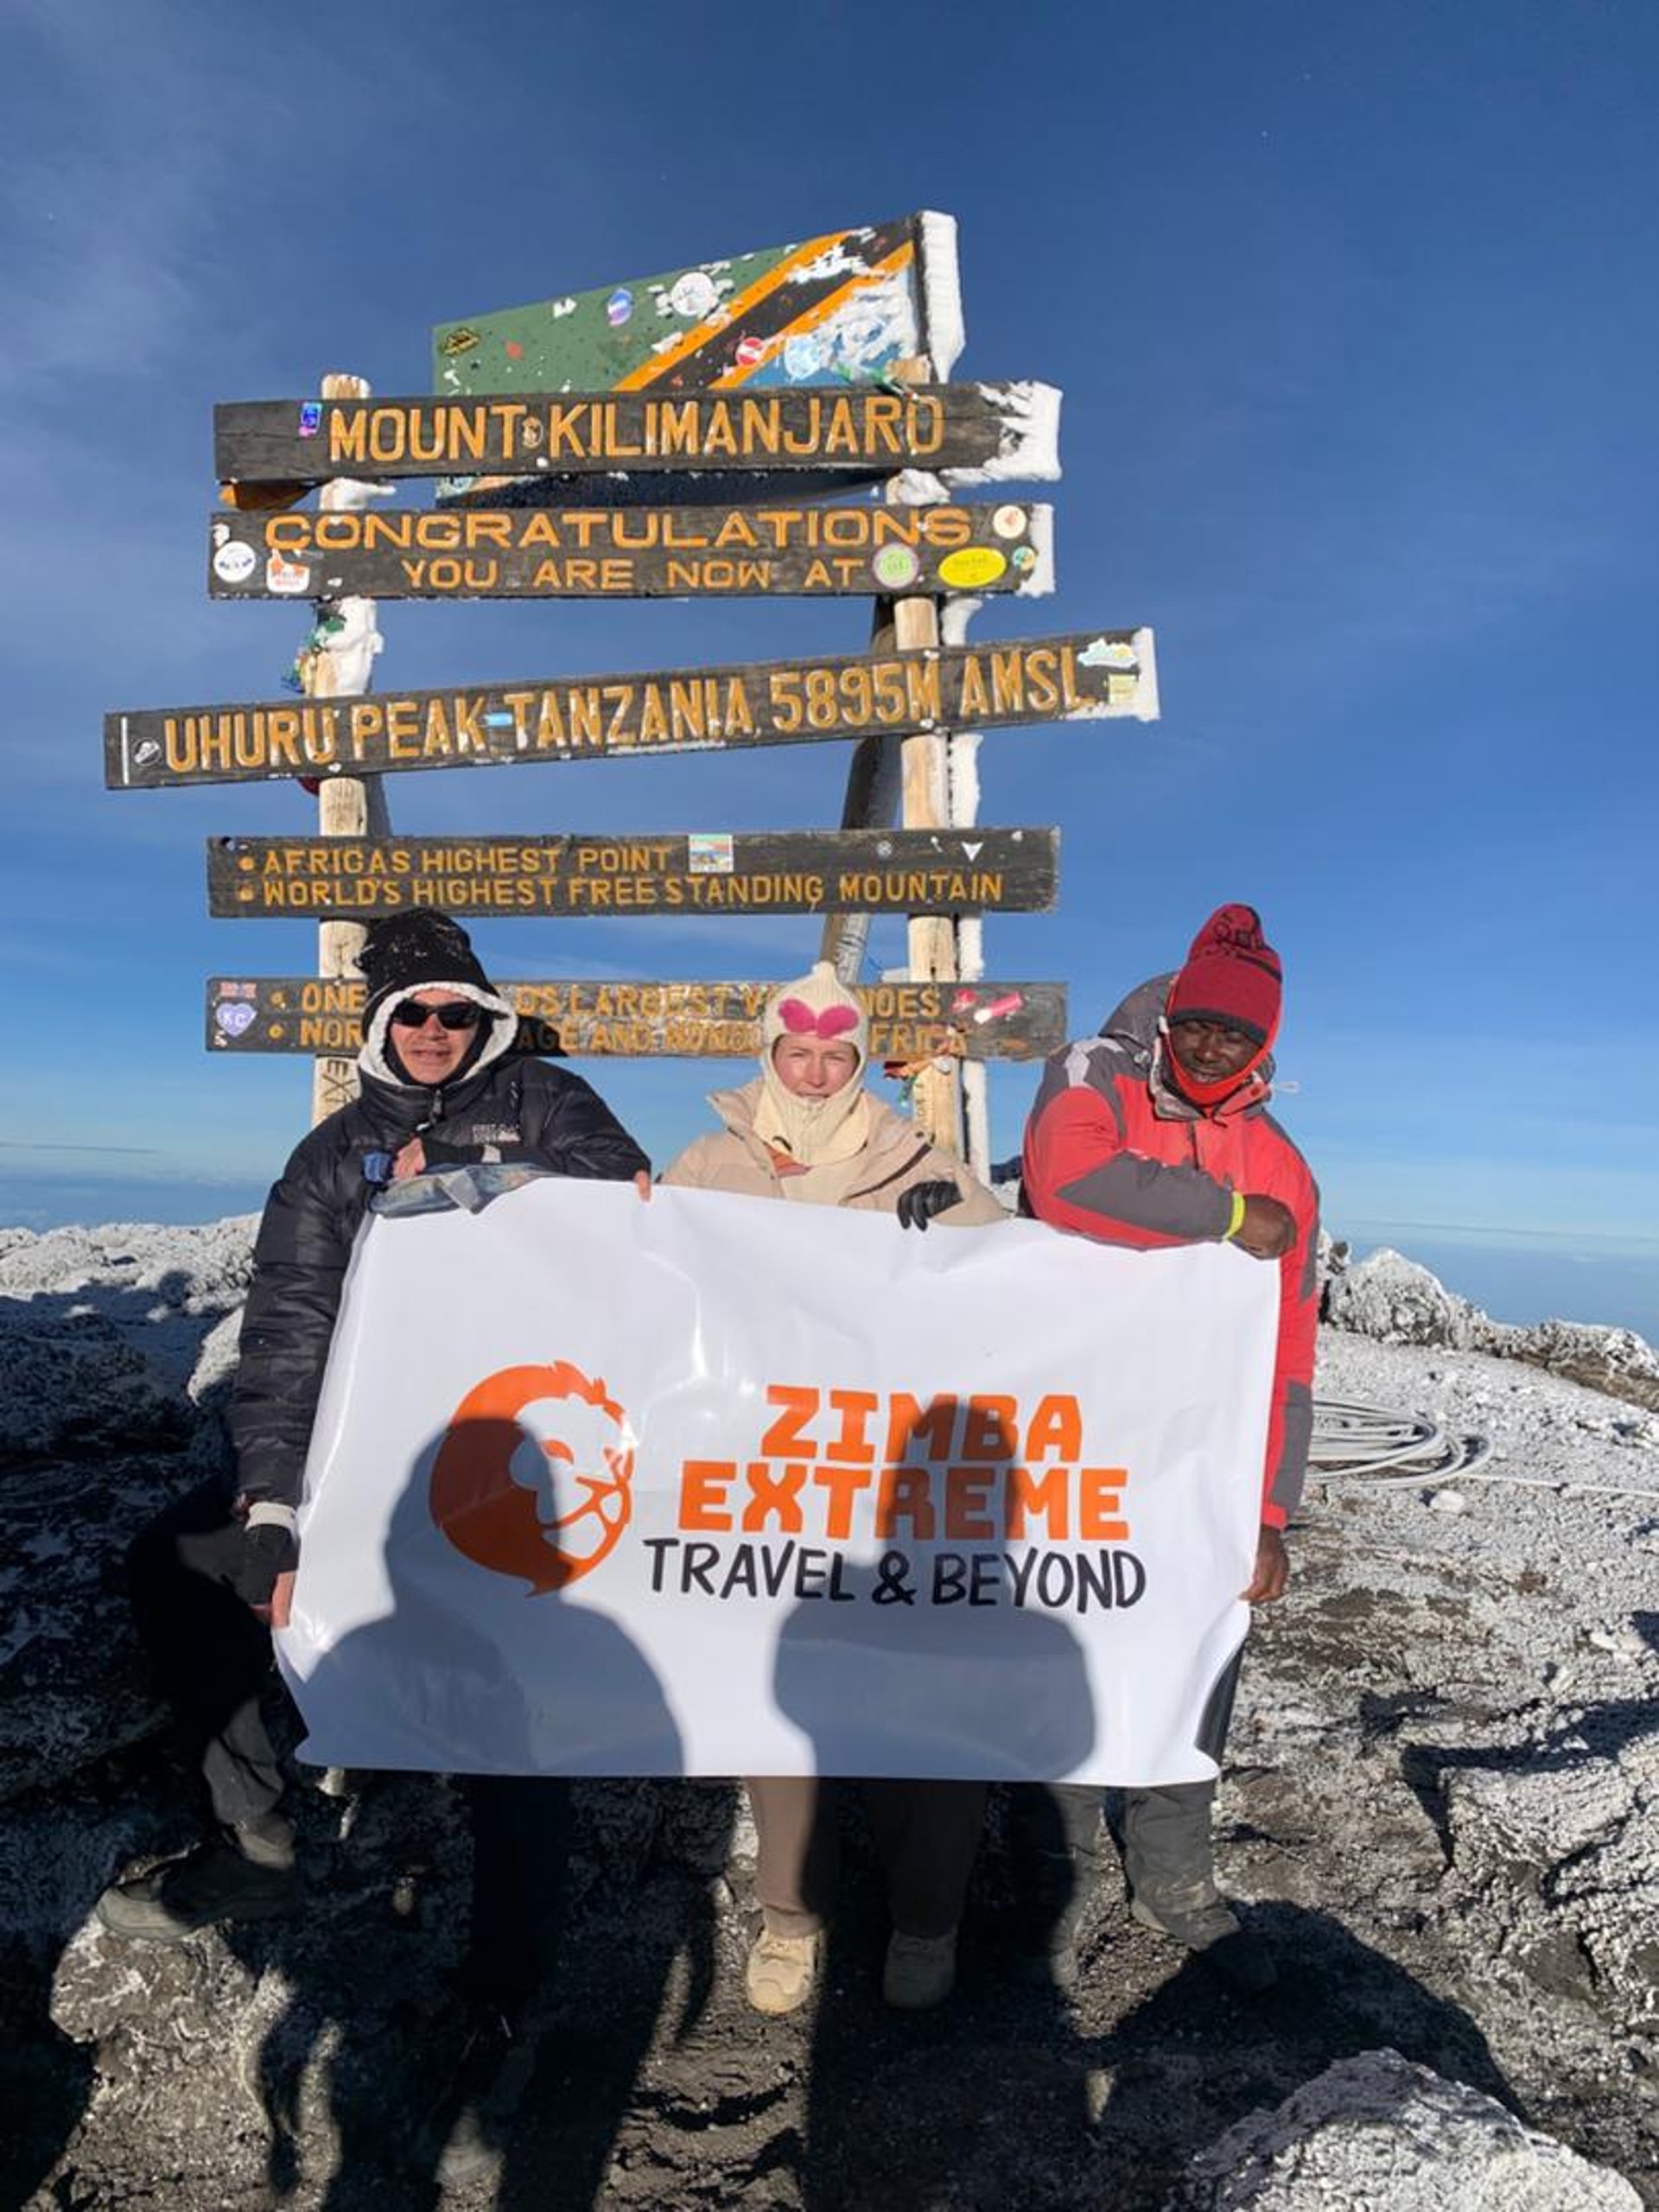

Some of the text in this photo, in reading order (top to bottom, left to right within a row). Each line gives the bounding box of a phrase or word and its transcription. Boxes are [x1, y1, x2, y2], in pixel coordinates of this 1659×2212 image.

[330, 395, 945, 463] MOUNT KILIMANJARO
[265, 510, 972, 550] CONGRATULATIONS
[402, 558, 499, 588] YOU
[533, 558, 634, 588] ARE
[667, 559, 772, 588] NOW
[804, 558, 864, 588] AT
[163, 707, 338, 772] UHURU
[769, 658, 942, 734] 5895M
[959, 645, 1098, 718] AMSL
[422, 848, 560, 874] HIGHEST
[580, 847, 671, 873] POINT
[412, 878, 557, 906] HIGHEST
[840, 873, 1003, 903] MOUNTAIN
[301, 982, 368, 1014] ONE
[760, 1384, 1084, 1464] ZIMBA
[677, 1459, 1130, 1541] EXTREME
[643, 1537, 1147, 1615] TRAVEL & BEYOND
